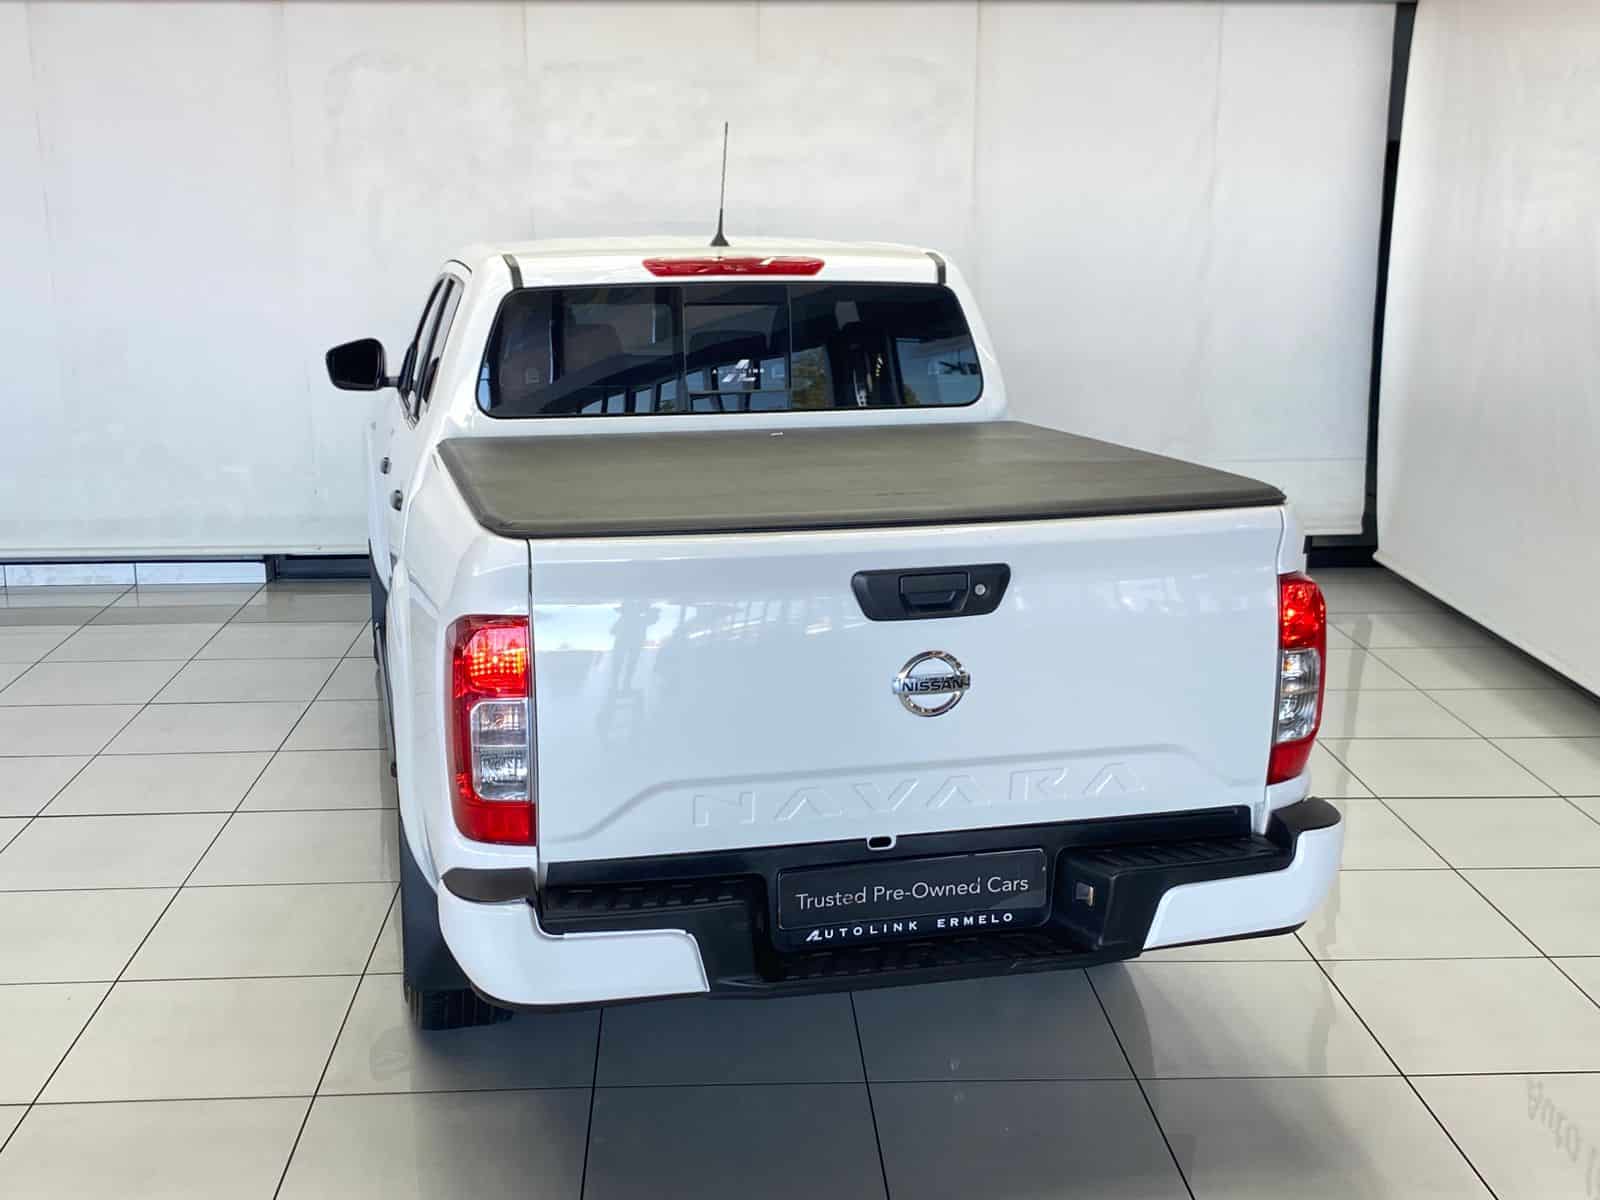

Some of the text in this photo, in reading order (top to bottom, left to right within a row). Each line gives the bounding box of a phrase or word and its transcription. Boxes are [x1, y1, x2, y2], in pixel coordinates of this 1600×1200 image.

[902, 679, 964, 692] NISSAN
[692, 762, 1146, 827] NAVARA
[796, 876, 1030, 911] Trusted Pre-Owned Cars
[806, 912, 1014, 942] AUTOLINK ERMELO
